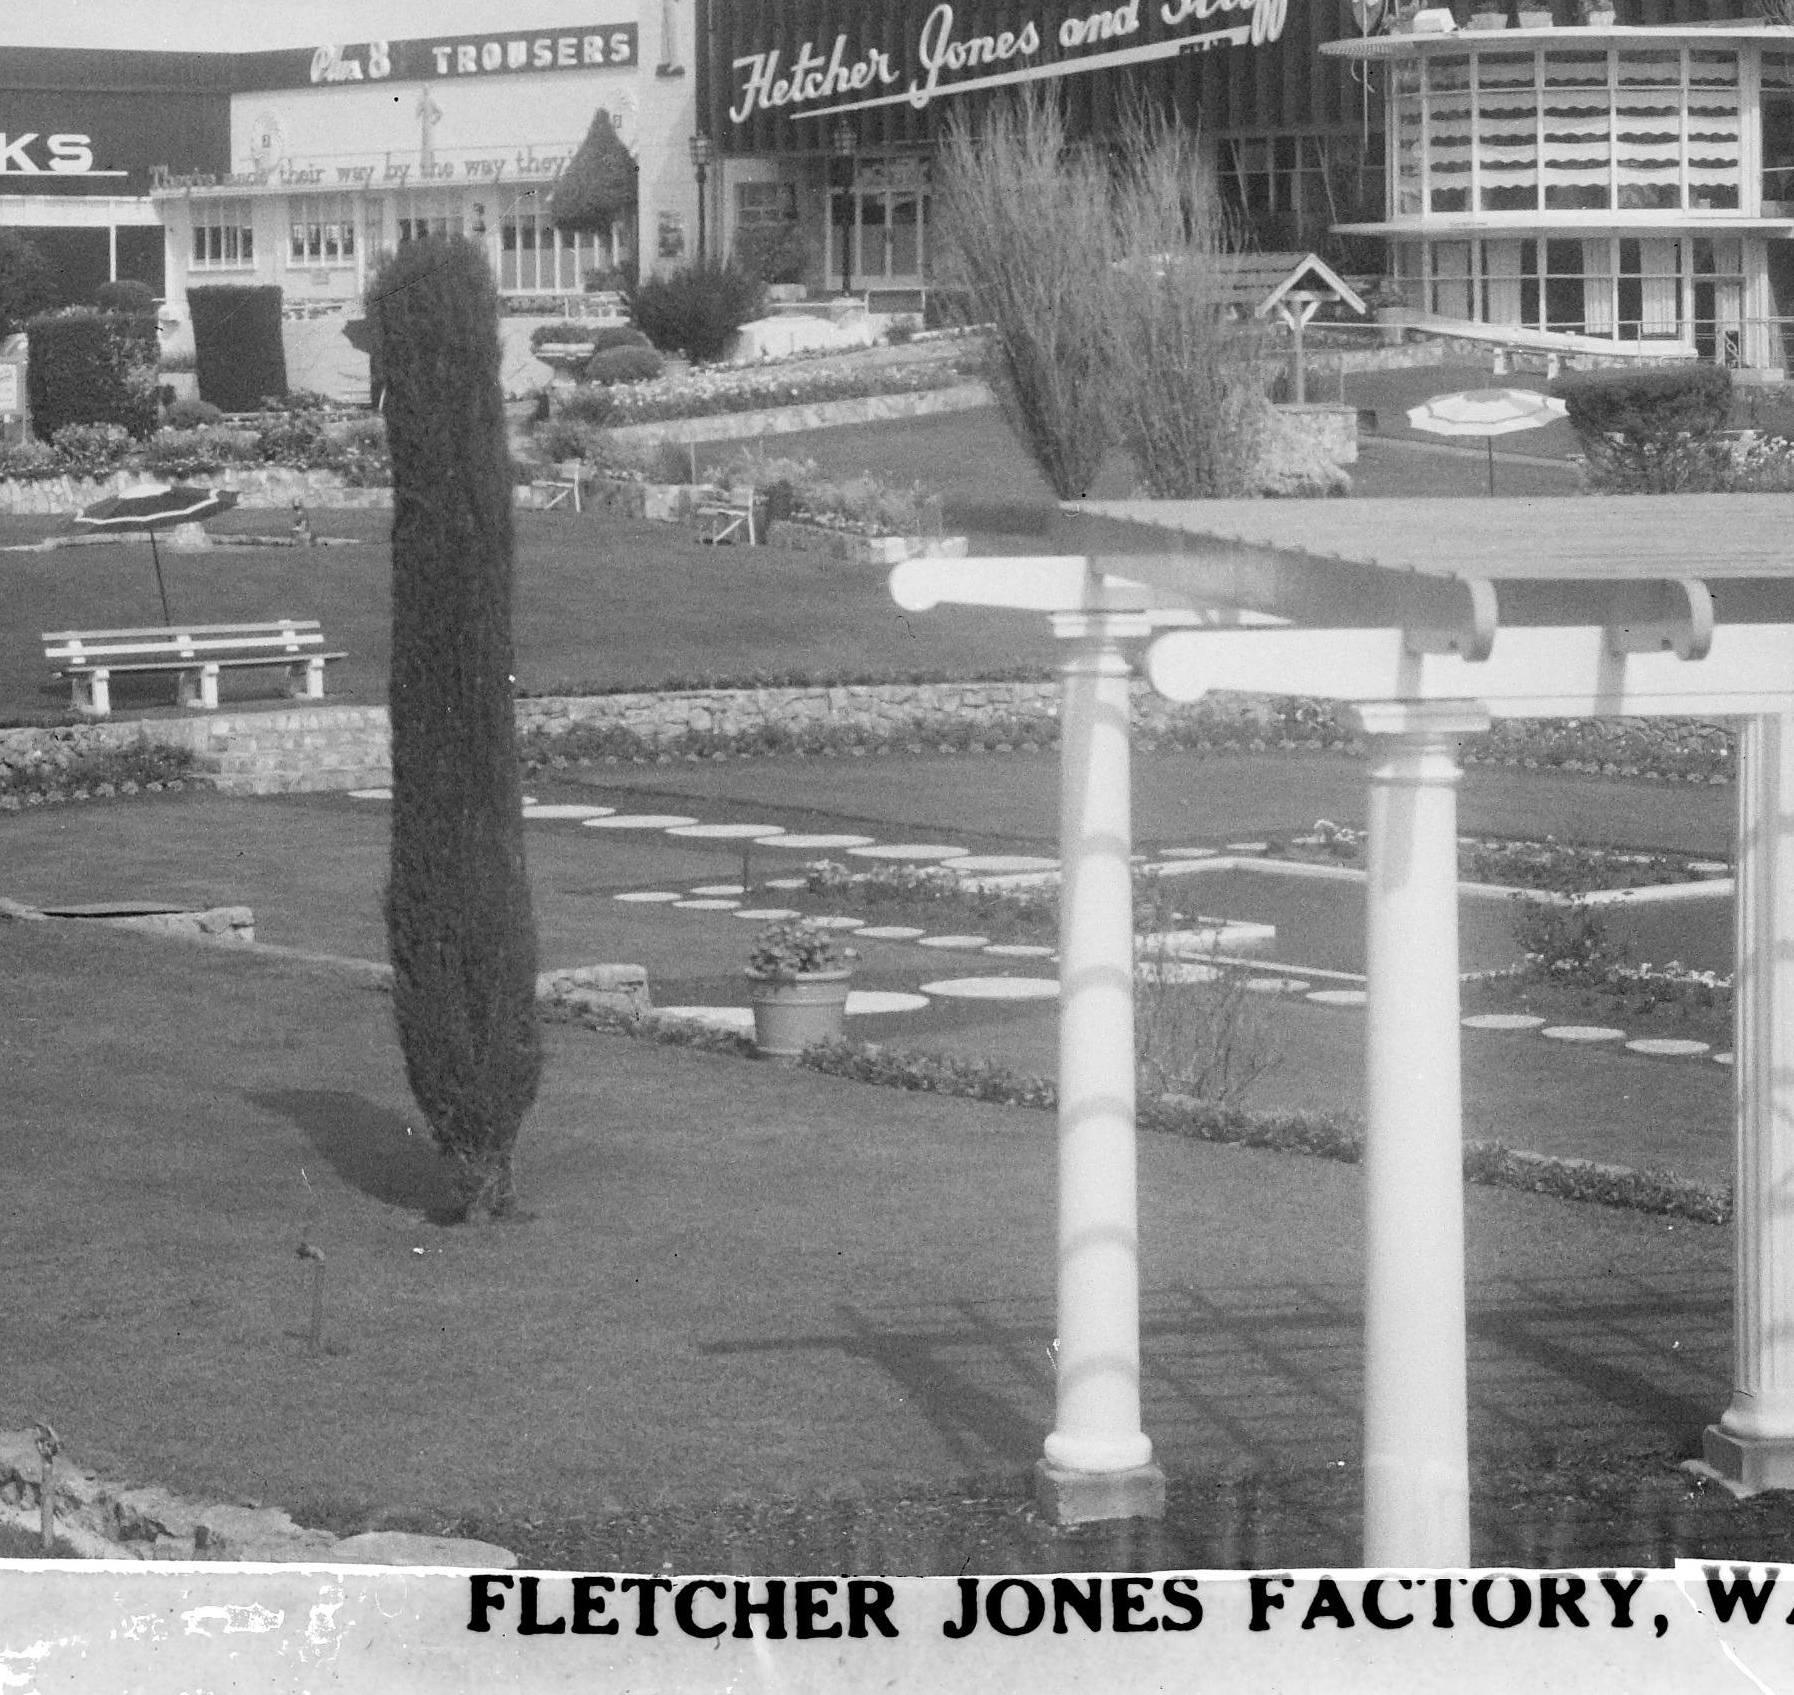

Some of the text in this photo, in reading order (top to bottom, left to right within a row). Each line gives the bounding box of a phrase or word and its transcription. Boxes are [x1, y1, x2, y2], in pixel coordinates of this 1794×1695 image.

[368, 39, 391, 79] 8
[431, 32, 630, 75] TROUSERS
[730, 35, 899, 122] Fletcher
[907, 3, 1040, 108] Jones
